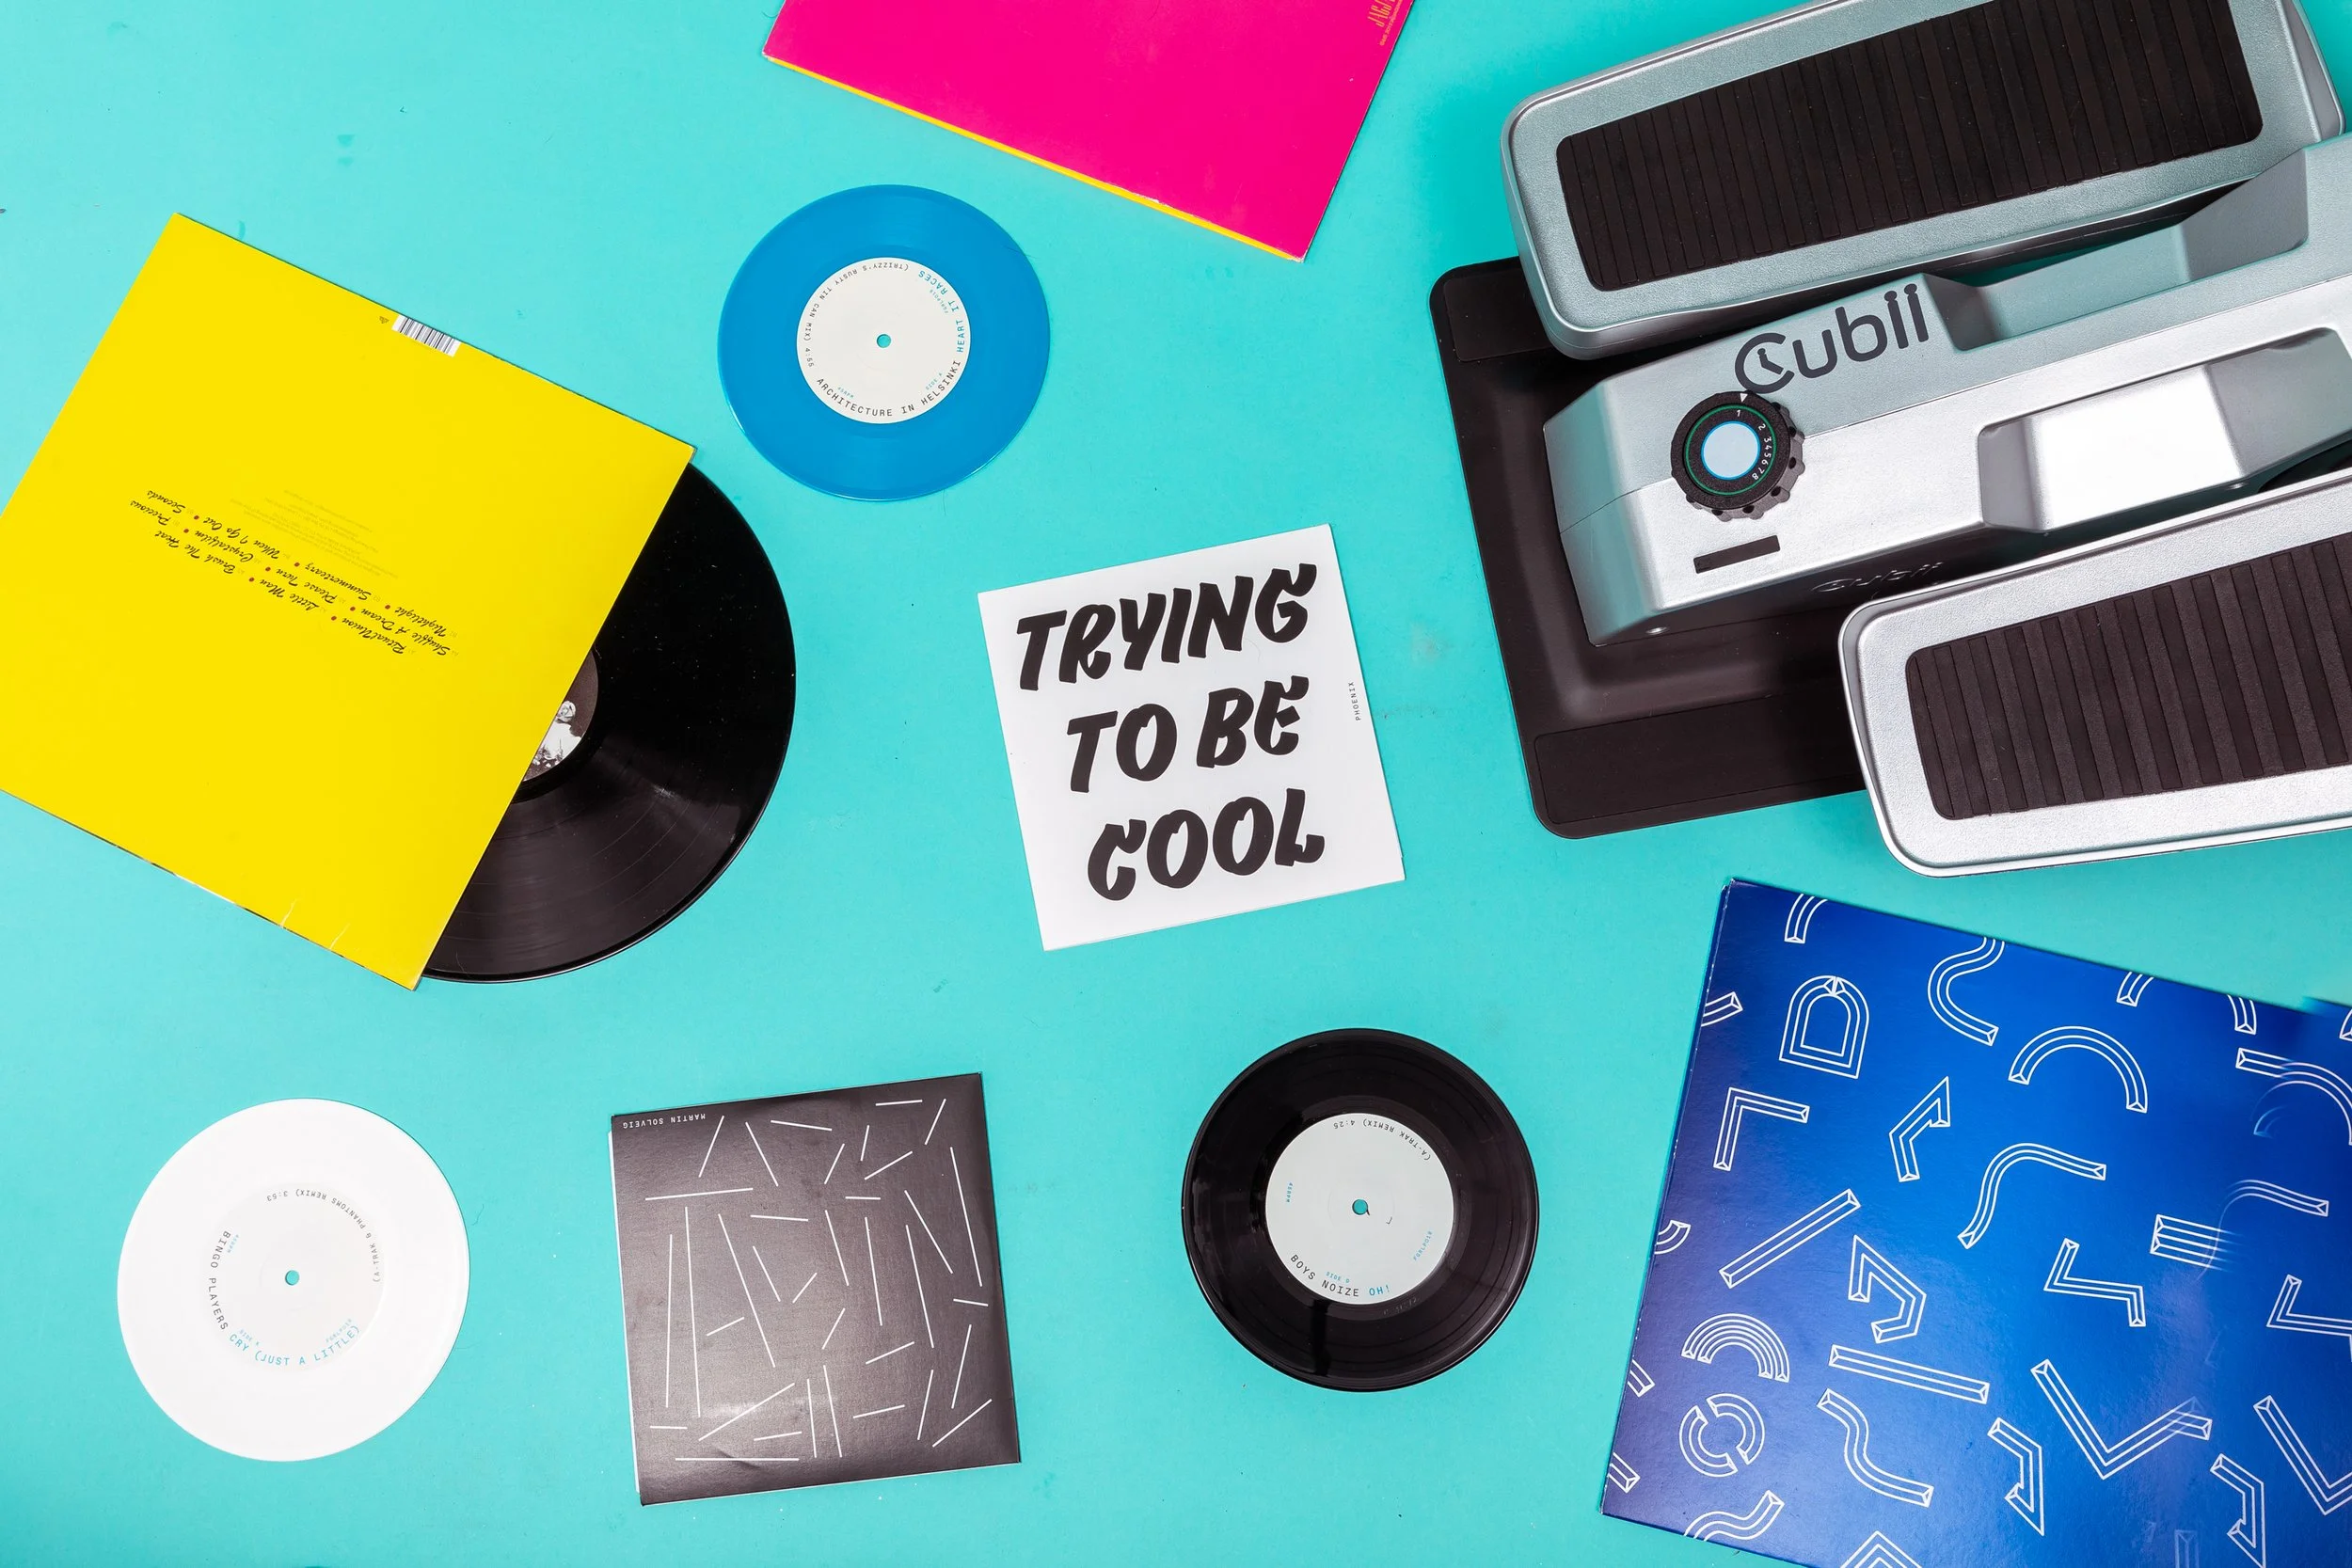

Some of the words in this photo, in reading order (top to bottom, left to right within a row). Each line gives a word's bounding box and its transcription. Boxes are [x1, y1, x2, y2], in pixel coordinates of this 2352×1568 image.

[835, 269, 858, 285] RUSTY
[918, 270, 947, 295] RACES
[819, 287, 833, 300] TIN
[809, 303, 819, 318] CAN
[948, 300, 960, 312] IT
[803, 322, 812, 341] MIX)
[956, 319, 965, 353] HEART
[1735, 283, 1929, 394] Cubii
[921, 360, 961, 405] HELSINKI
[817, 378, 893, 417] ARCHITECTURE
[901, 404, 914, 414] IN
[148, 491, 185, 513] Seconds
[131, 501, 170, 525] Precious
[203, 517, 222, 531] Out
[184, 545, 199, 559] The
[254, 541, 279, 559] When
[204, 555, 235, 574] Brush
[260, 579, 285, 597] Man
[304, 582, 337, 603] Please
[290, 594, 319, 610] Little
[361, 609, 394, 630] Dream
[395, 608, 446, 637] Nightlight
[1016, 562, 1317, 691] TRYING
[412, 633, 450, 656] Shuffle
[1348, 682, 1361, 721] PHOENIX
[1067, 704, 1178, 793] TO
[1196, 675, 1310, 768] BE
[1088, 788, 1325, 901] COOL
[623, 1117, 664, 1129] SOLVEIG
[670, 1114, 706, 1123] MARTIN
[1333, 1119, 1356, 1129] 4:25
[1363, 1118, 1394, 1132] REMIX)
[1399, 1131, 1431, 1161] (A-TRAK
[295, 1188, 327, 1200] REMIX)
[331, 1197, 366, 1229] PHANTOMS
[210, 1230, 231, 1269] BINGO
[370, 1243, 381, 1282] (A-TRAK
[1290, 1254, 1316, 1280] BOYS
[1321, 1279, 1359, 1297] NOIZE
[1369, 1285, 1390, 1296] OH!
[208, 1277, 229, 1330] PLAYERS
[230, 1333, 249, 1352] CRY
[314, 1325, 359, 1361] LITTLE)
[254, 1350, 290, 1366] (JUST
[299, 1356, 306, 1365] A
